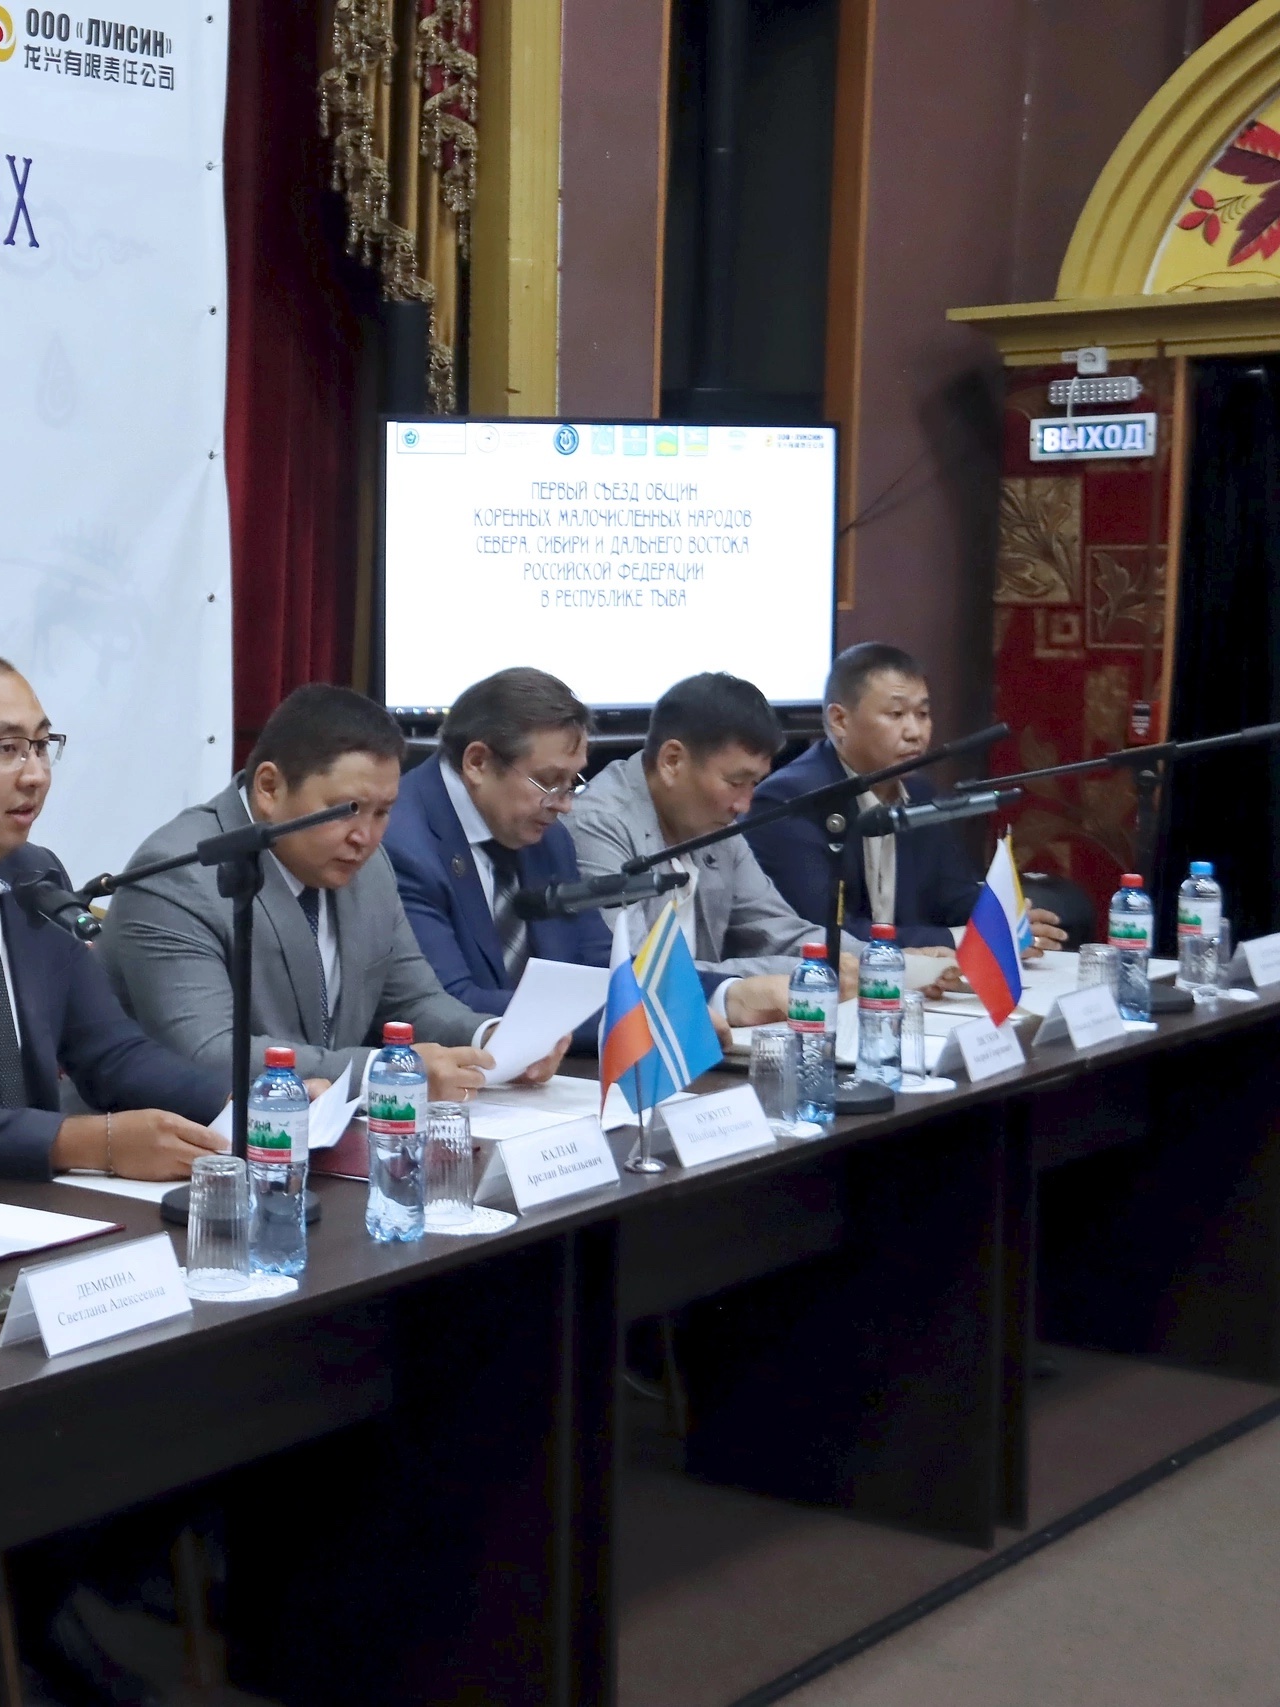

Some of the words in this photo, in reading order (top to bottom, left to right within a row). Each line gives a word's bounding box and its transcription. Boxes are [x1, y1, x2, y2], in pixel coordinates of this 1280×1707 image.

[25, 8, 70, 42] ООО
[76, 18, 172, 58] «ЛУНСИН»
[23, 44, 175, 91] 龙兴有限责任公司
[1043, 423, 1145, 452] ВЫХОД
[531, 480, 588, 500] ПЕРВЫЙ
[593, 482, 640, 502] СЪЕЗД
[645, 482, 698, 502] ОБЩИН
[474, 508, 552, 528] КОРЕННЫХ
[558, 509, 682, 528] МАЛОЧИСЛЕННЫХ
[687, 509, 753, 529] НАРОДОВ
[536, 535, 589, 554] СИБИРИ
[595, 535, 604, 554] И
[609, 535, 683, 556] ДАЛЬНЕГО
[688, 535, 750, 554] ВОСТОКА
[523, 561, 612, 581] РОССИЙСКОЙ
[617, 562, 704, 583] ФЕДЕРАЦИИ
[540, 589, 550, 608] В
[555, 588, 644, 608] РЕСПУБЛИКЕ
[650, 588, 688, 608] ТЫВА
[527, 1169, 558, 1187] Арслан
[557, 1156, 603, 1176] Васильевич
[77, 1270, 136, 1300] ДЕМКИНА
[57, 1302, 108, 1326] Светлана
[109, 1285, 166, 1312] Алексеевна
